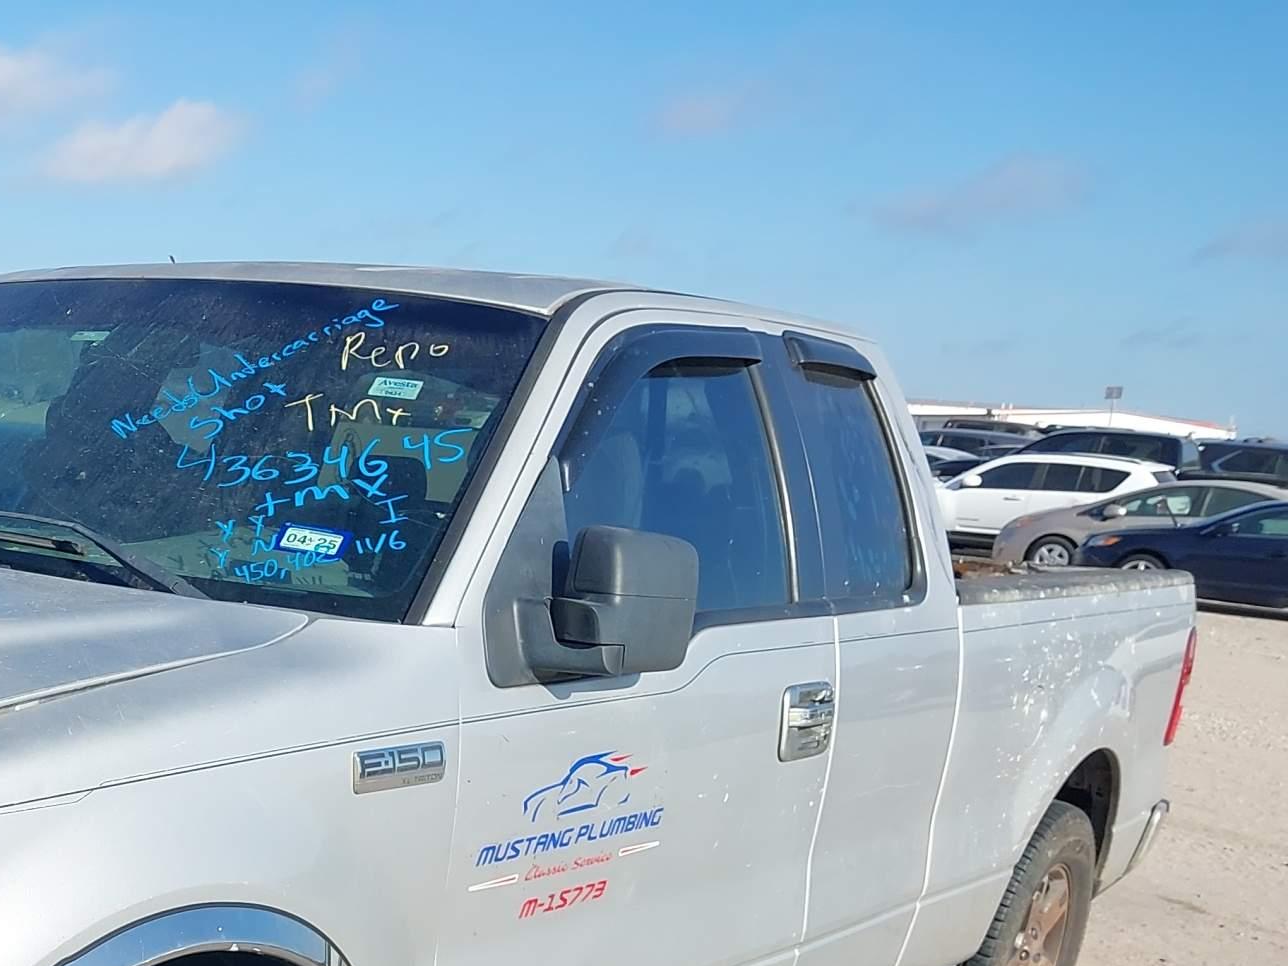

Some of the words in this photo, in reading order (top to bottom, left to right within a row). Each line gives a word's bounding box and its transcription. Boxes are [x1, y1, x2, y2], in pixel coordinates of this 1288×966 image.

[111, 391, 199, 440] Needs
[188, 298, 399, 400] Undercarriage
[359, 743, 444, 779] F-150
[475, 828, 575, 867] MUSTANG
[574, 807, 665, 844] PLUMBING
[524, 863, 569, 882] Classic
[518, 880, 608, 919] M-15773
